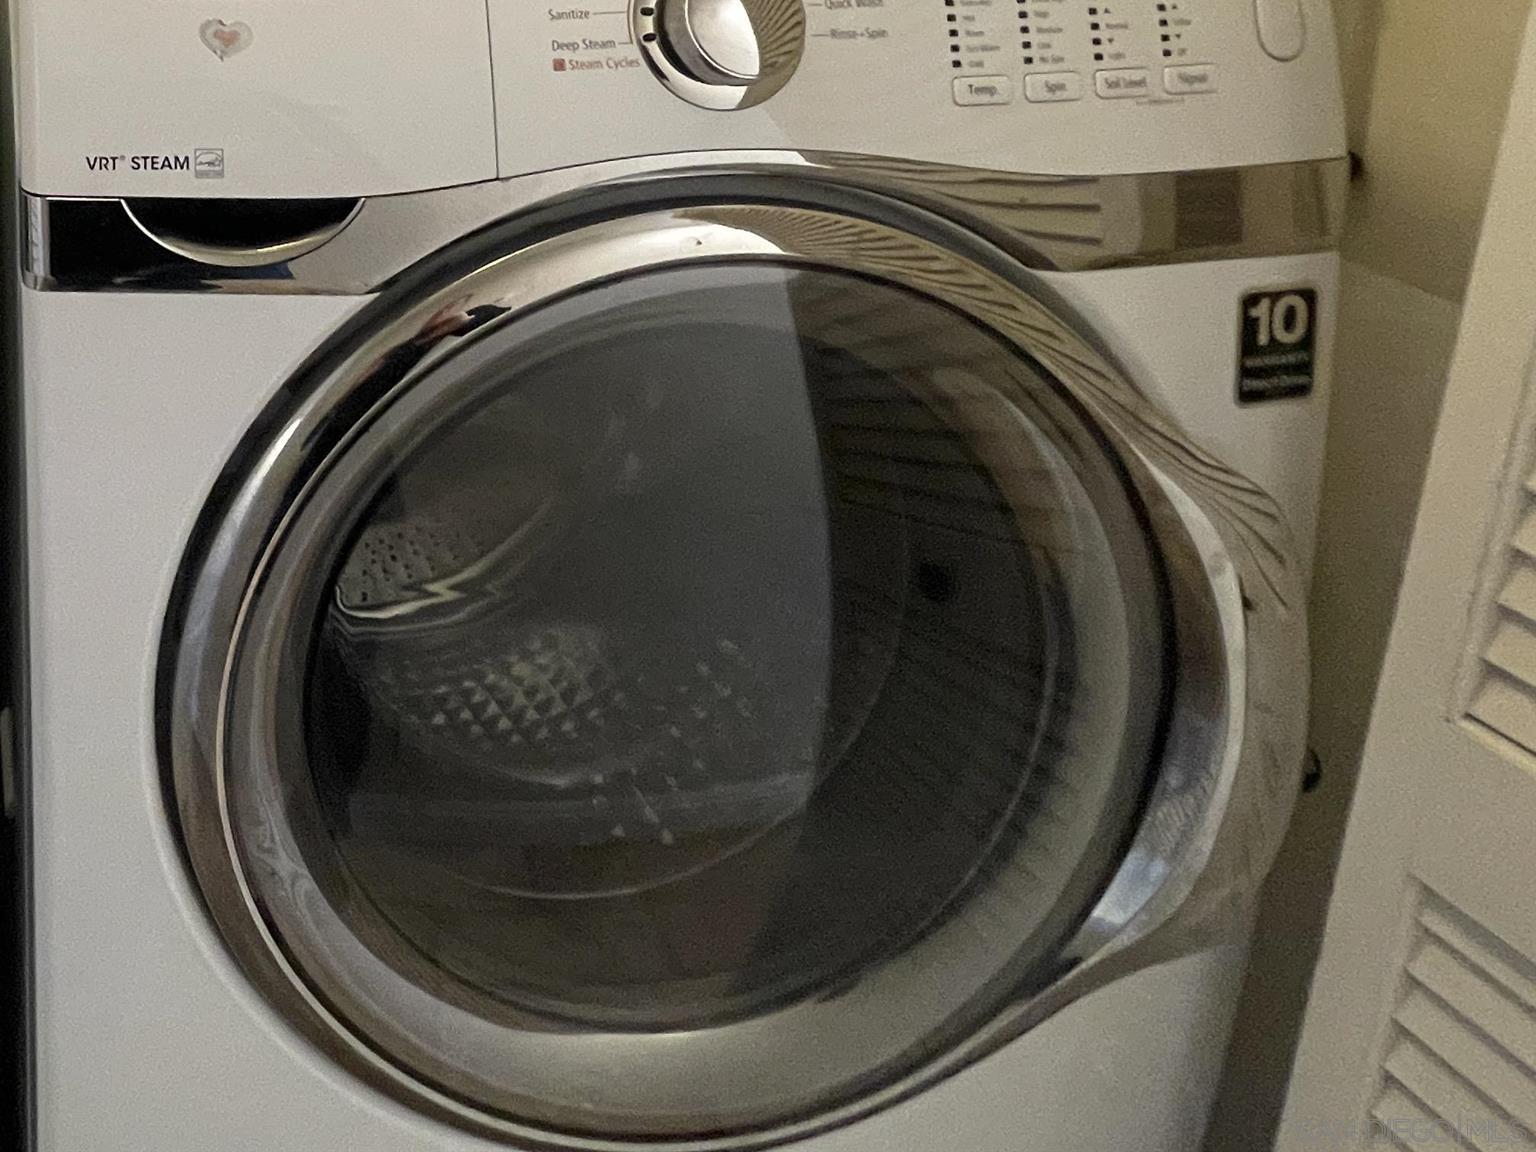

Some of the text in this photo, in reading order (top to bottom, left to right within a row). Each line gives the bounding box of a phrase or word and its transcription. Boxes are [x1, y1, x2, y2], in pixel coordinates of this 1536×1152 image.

[547, 8, 591, 21] Sanitize
[551, 37, 617, 54] Deep Steam
[568, 56, 641, 71] Steam Cycles
[131, 155, 190, 172] STEAM
[1248, 294, 1309, 346] 10
